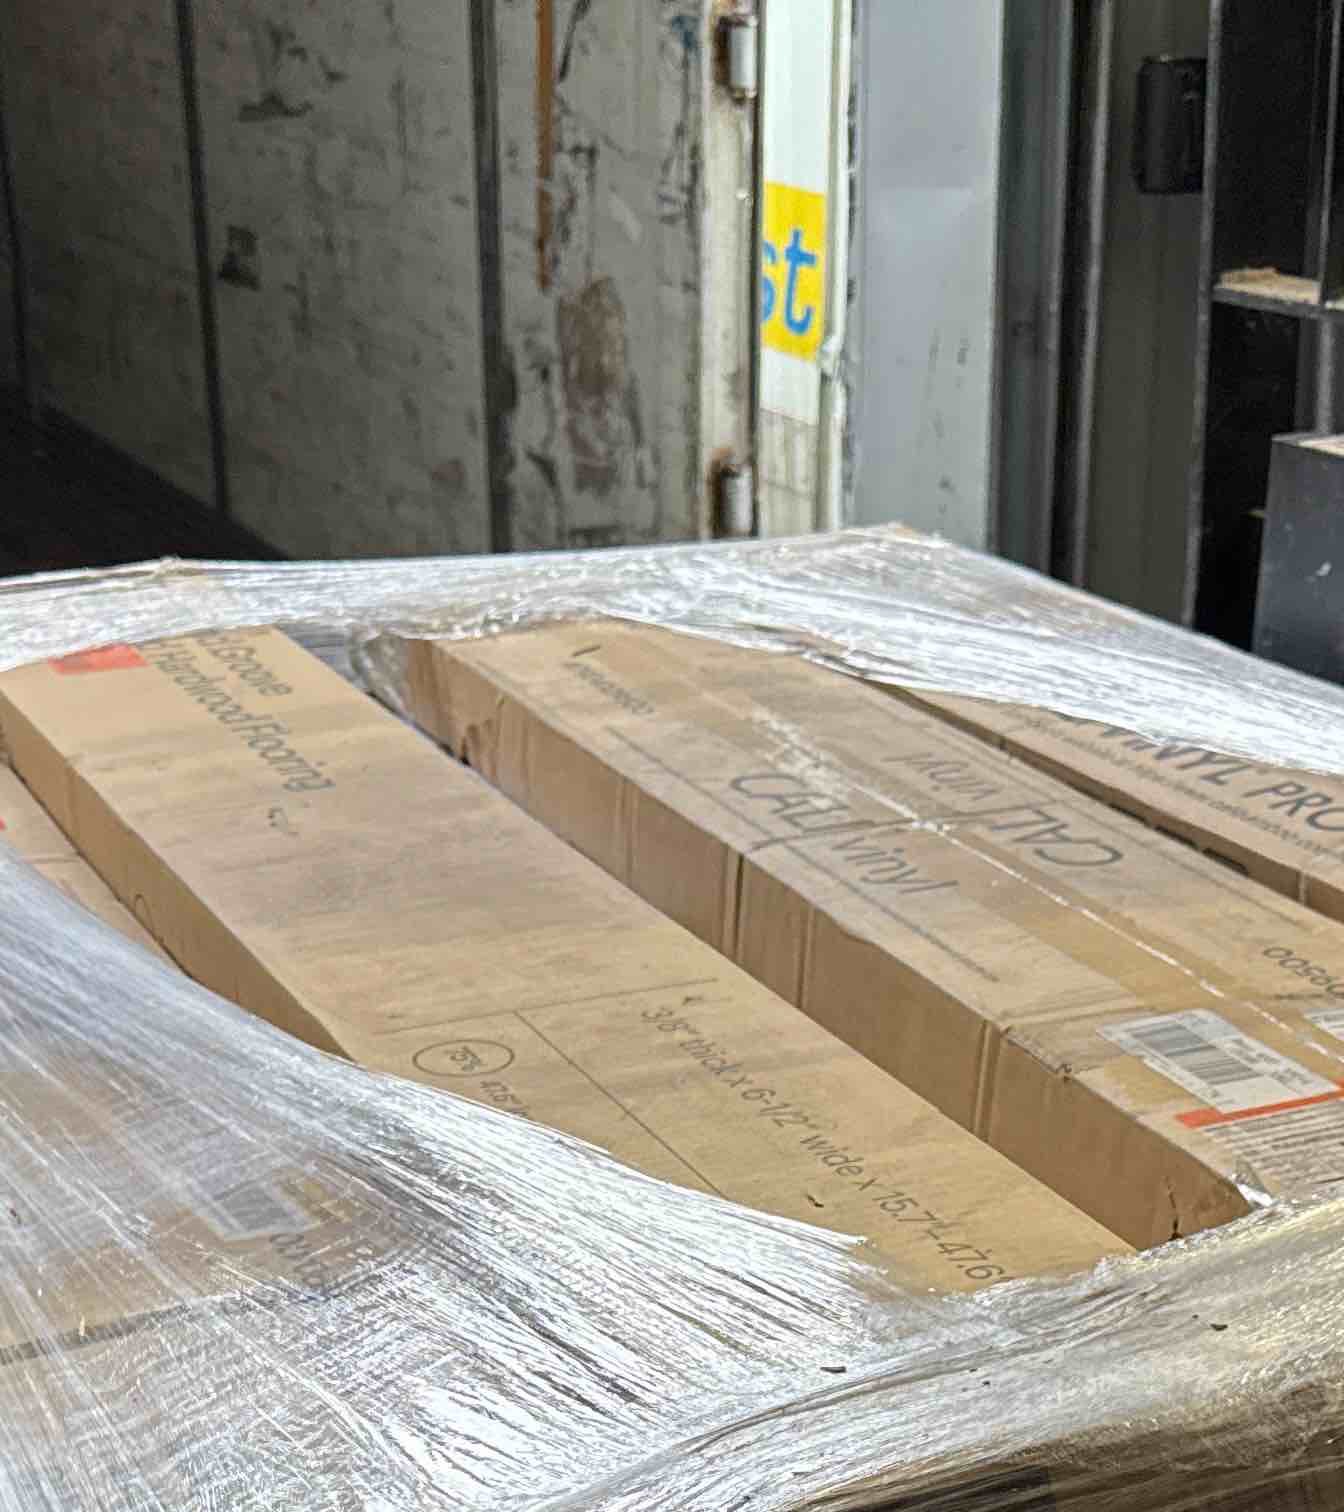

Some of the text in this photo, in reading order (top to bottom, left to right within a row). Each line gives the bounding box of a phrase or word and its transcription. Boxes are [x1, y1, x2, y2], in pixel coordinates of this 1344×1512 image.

[231, 716, 337, 793] Flooring
[678, 1035, 743, 1077] thick
[799, 1132, 864, 1178] wide
